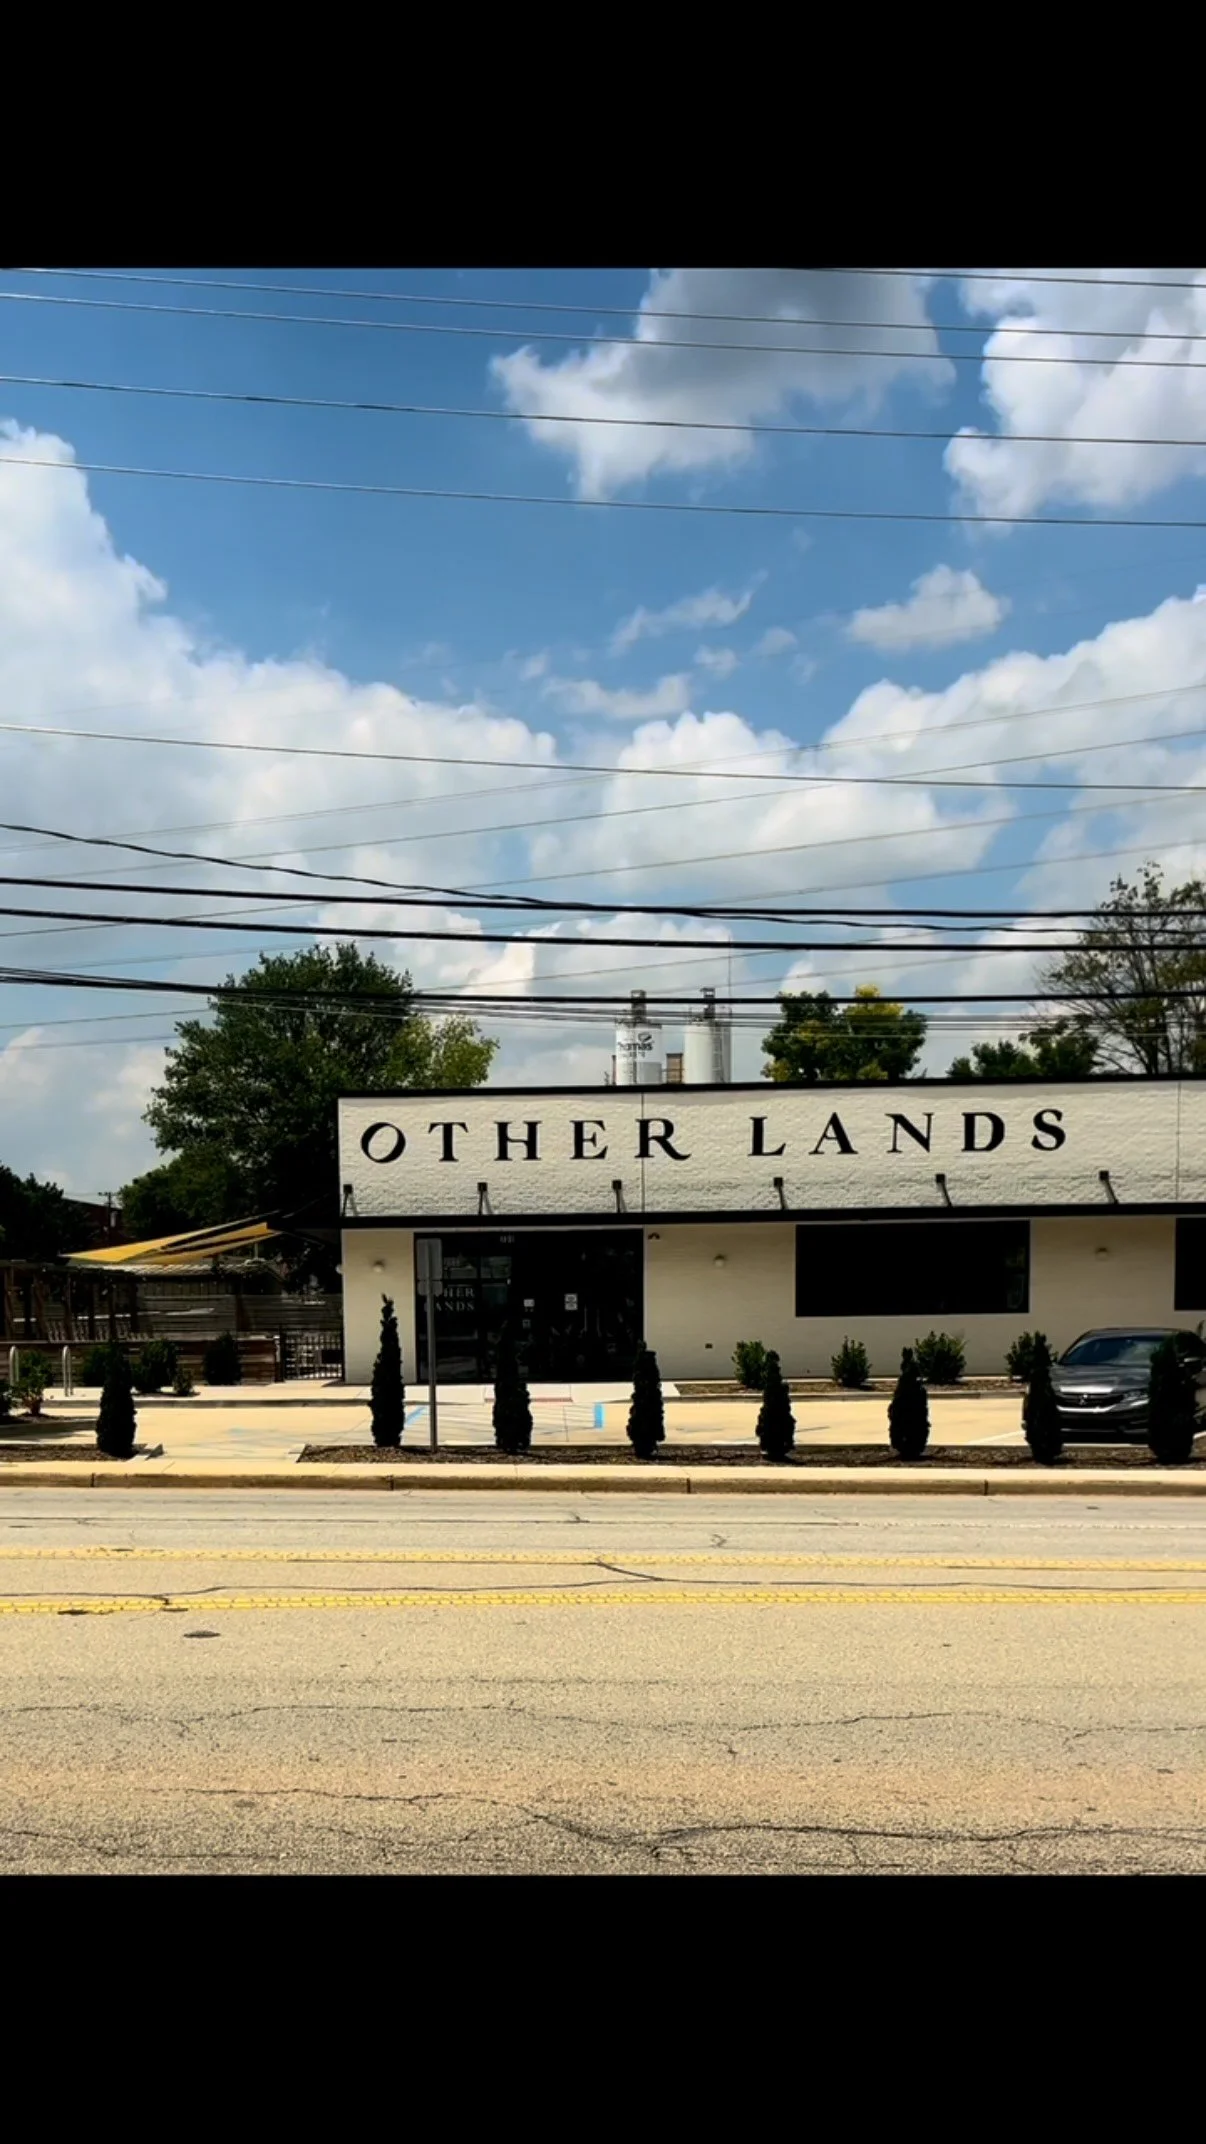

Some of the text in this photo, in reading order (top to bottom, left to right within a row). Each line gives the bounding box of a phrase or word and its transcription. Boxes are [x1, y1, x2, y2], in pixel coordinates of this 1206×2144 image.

[361, 1109, 1066, 1163] OTHER LANDS
[434, 1287, 476, 1299] HER
